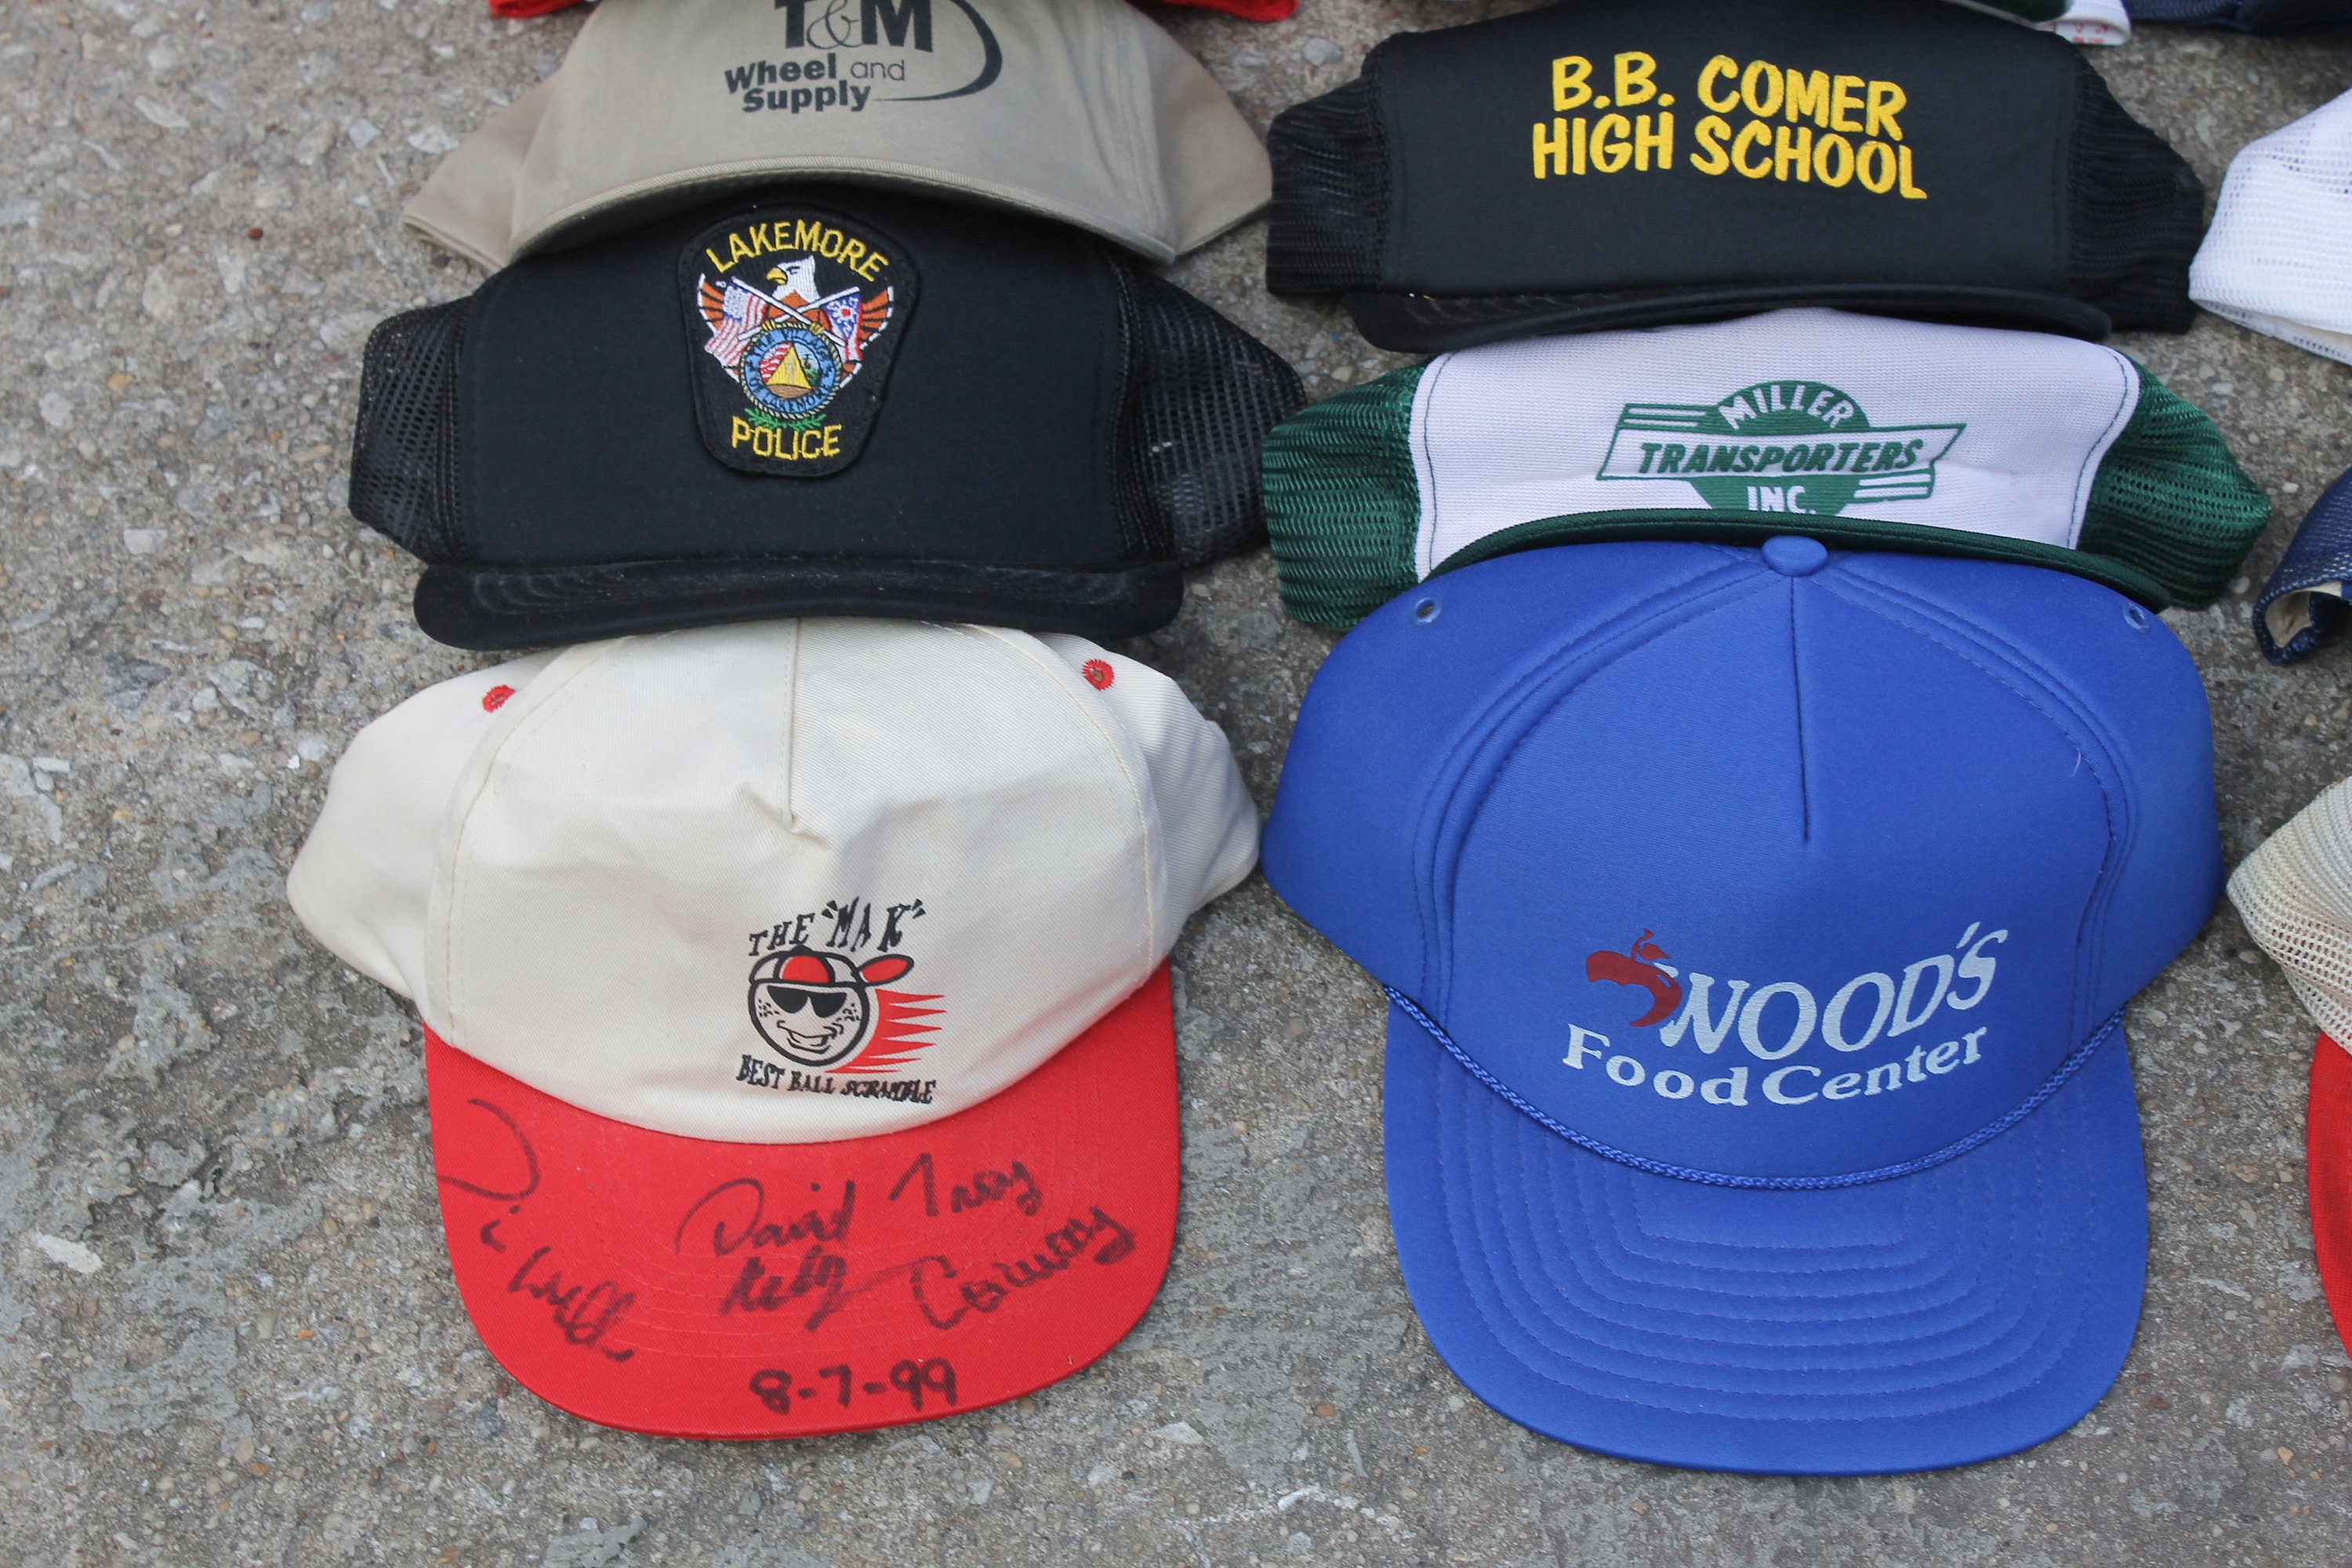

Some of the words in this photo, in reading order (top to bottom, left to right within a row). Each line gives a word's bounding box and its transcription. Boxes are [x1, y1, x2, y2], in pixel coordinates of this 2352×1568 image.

[775, 0, 933, 52] T&M
[724, 53, 837, 93] Wheel
[850, 60, 906, 81] and
[742, 80, 871, 114] Supply
[1552, 51, 1675, 111] B.B.
[1697, 54, 1907, 141] COMER
[1532, 111, 1674, 180] HIGH
[1689, 114, 1928, 199] SCHOOL
[706, 219, 890, 282] LAKEMORE
[1718, 383, 1855, 431] MILLER
[731, 415, 843, 461] POLICE
[1638, 438, 1924, 474] TRANSPORTERS
[748, 913, 815, 956] THE
[1653, 921, 2009, 1061] WOOD'S
[735, 1054, 786, 1090] BEST
[786, 1070, 837, 1095] BALL
[1562, 1023, 1749, 1107] Food
[1761, 1026, 1987, 1106] Center
[749, 1357, 958, 1416] 8-7-99
